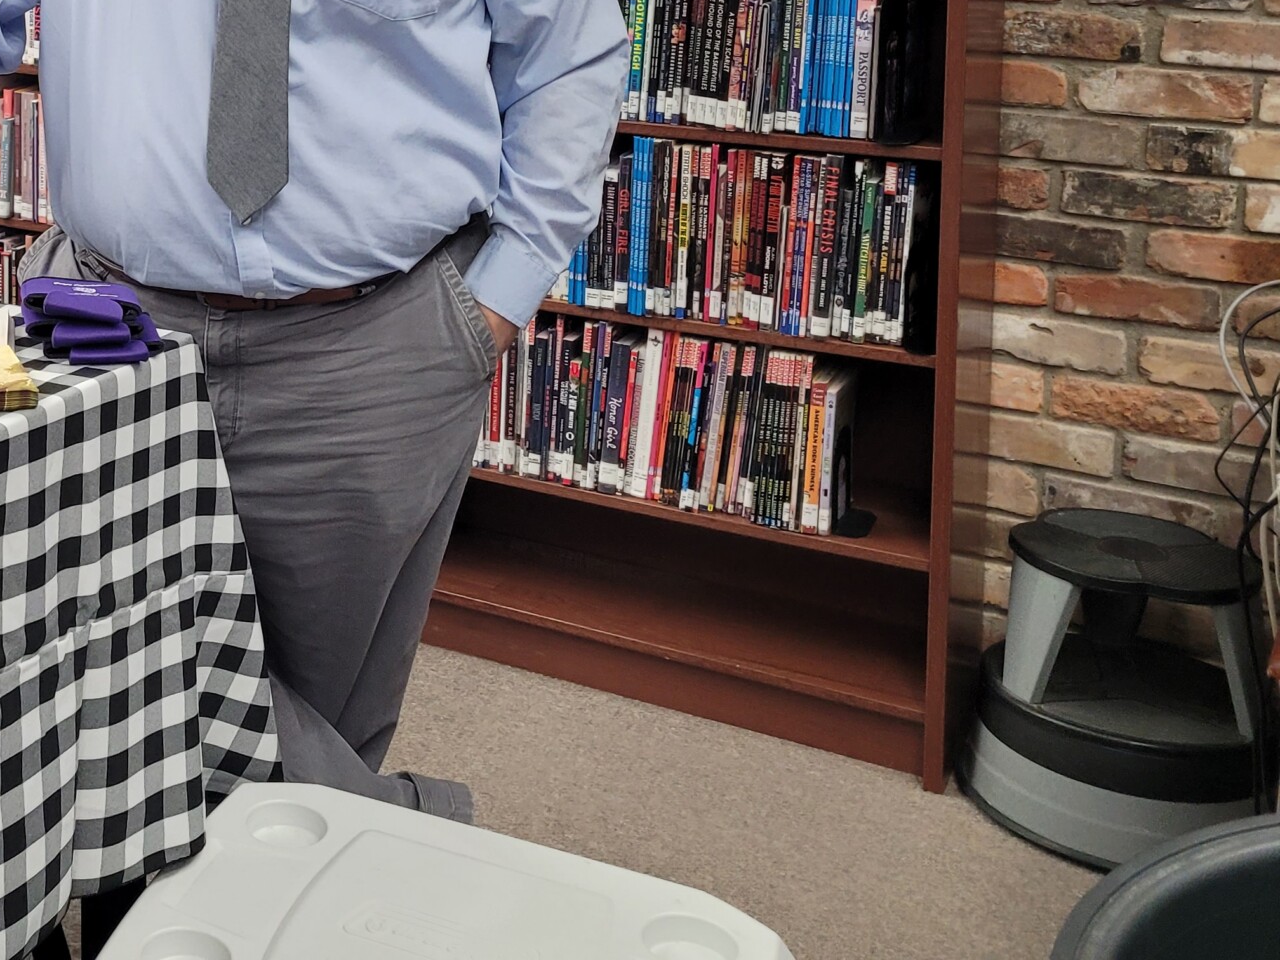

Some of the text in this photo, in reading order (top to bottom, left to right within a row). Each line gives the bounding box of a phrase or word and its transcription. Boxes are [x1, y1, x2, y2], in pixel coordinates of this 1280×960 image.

[707, 3, 715, 27] HOUND
[715, 4, 724, 28] HOUND
[726, 17, 735, 38] STUDY
[687, 26, 695, 62] PRODIGAL
[693, 28, 702, 64] PRODIGAL
[704, 39, 712, 50] THE
[706, 28, 713, 37] OF
[715, 29, 722, 38] OF
[726, 38, 733, 46] IN
[782, 23, 792, 52] BEAST BOY
[793, 28, 802, 49] RAVEN
[632, 43, 642, 70] HIGH
[723, 47, 732, 73] SCARLET
[700, 50, 711, 91] BASKERVILLES
[709, 51, 720, 92] BASKERVILLES
[856, 51, 869, 106] PASSPORT
[682, 150, 690, 174] STATIC
[753, 156, 761, 178] MARVEL
[760, 158, 768, 180] MARVEL
[802, 162, 813, 219] ALL-STAR SUPERMAN
[884, 165, 897, 192] MARVEL
[766, 182, 782, 233] FOR VENDETTA
[790, 189, 798, 220] SUPERMAN
[820, 166, 841, 254] FINAL CRISIS
[618, 189, 630, 254] GIRL FIRE
[881, 205, 892, 244] DEADPOOL
[857, 233, 870, 296] WITCH HIRE
[879, 251, 889, 273] CABLE
[636, 358, 645, 373] Una
[606, 397, 622, 449] Honor Girl
[812, 408, 820, 443] AMERICAN
